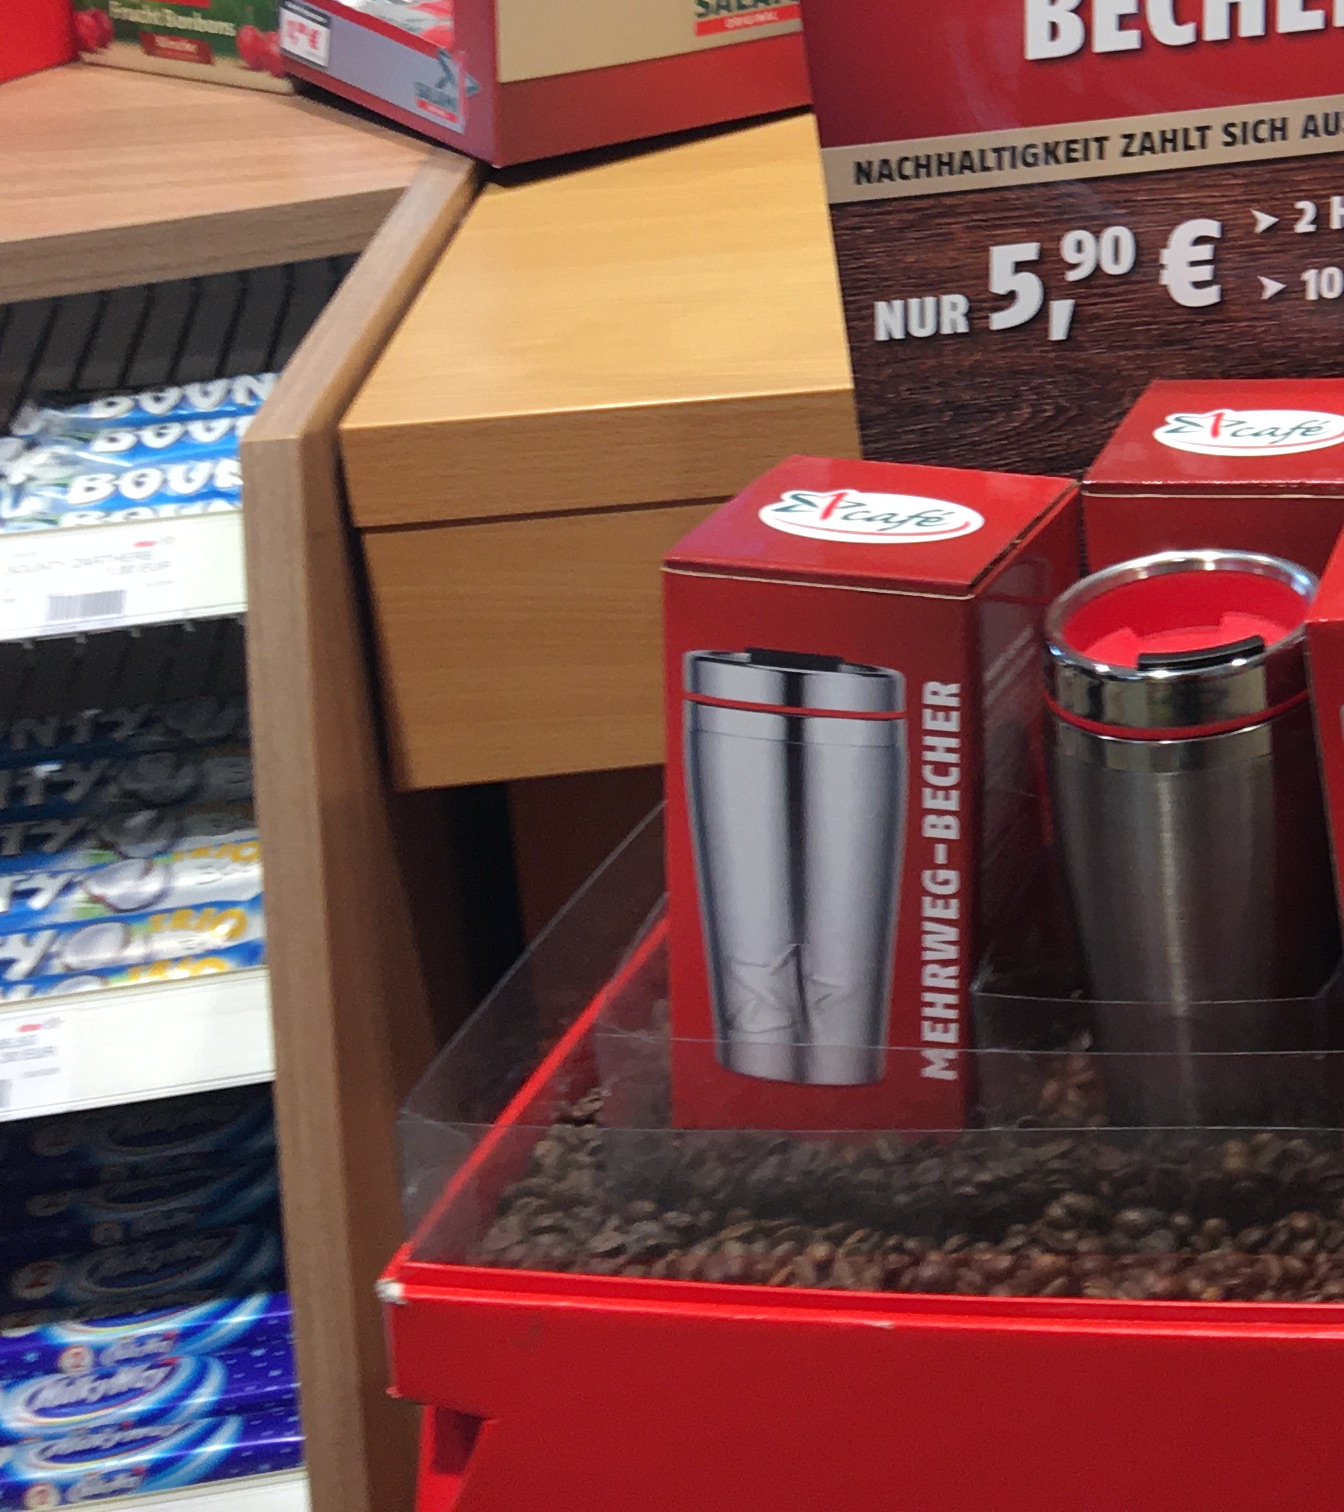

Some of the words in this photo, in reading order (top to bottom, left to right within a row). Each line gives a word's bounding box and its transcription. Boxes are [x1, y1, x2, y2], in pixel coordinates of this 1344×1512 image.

[853, 136, 1108, 186] NACHHALTIGKEIT
[1120, 124, 1213, 158] ZAHLT
[1222, 116, 1289, 148] SICH
[1294, 200, 1317, 233] 2
[874, 293, 971, 341] NUR
[1158, 219, 1223, 308] €
[1301, 267, 1344, 300] 10
[1231, 419, 1328, 444] café
[846, 508, 953, 532] café
[921, 680, 961, 1081] MEHRWEG-BECHER
